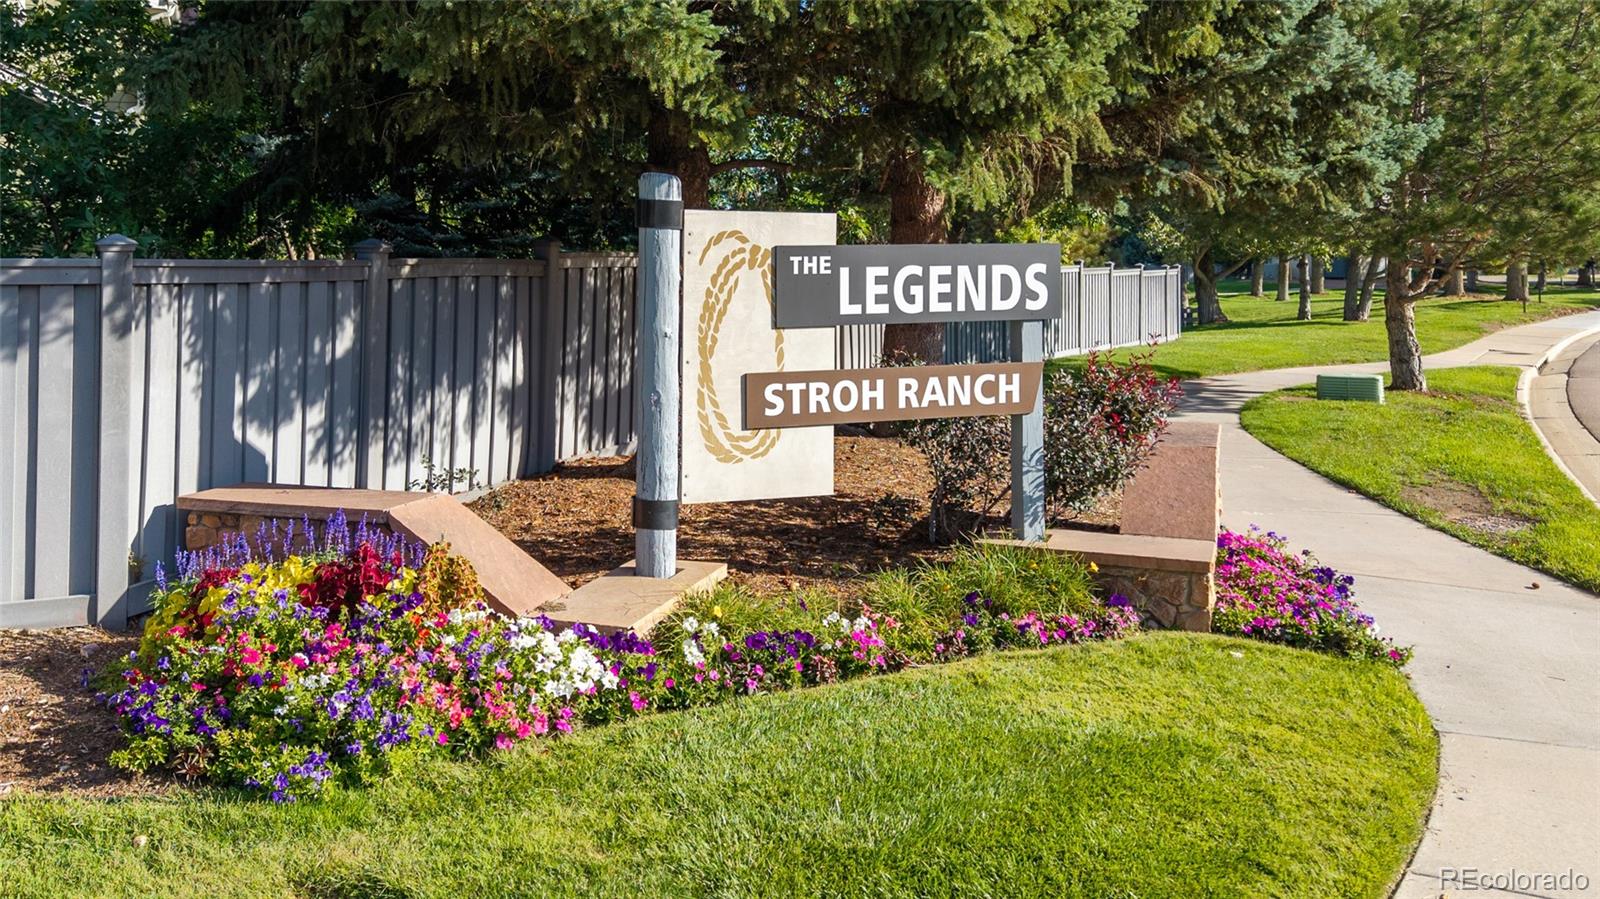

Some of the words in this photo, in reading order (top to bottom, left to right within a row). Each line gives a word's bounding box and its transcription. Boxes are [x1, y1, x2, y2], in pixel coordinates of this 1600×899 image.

[789, 256, 831, 275] THE
[839, 263, 1049, 315] LEGENDS
[764, 378, 884, 416] STROH
[898, 373, 1020, 409] RANCH
